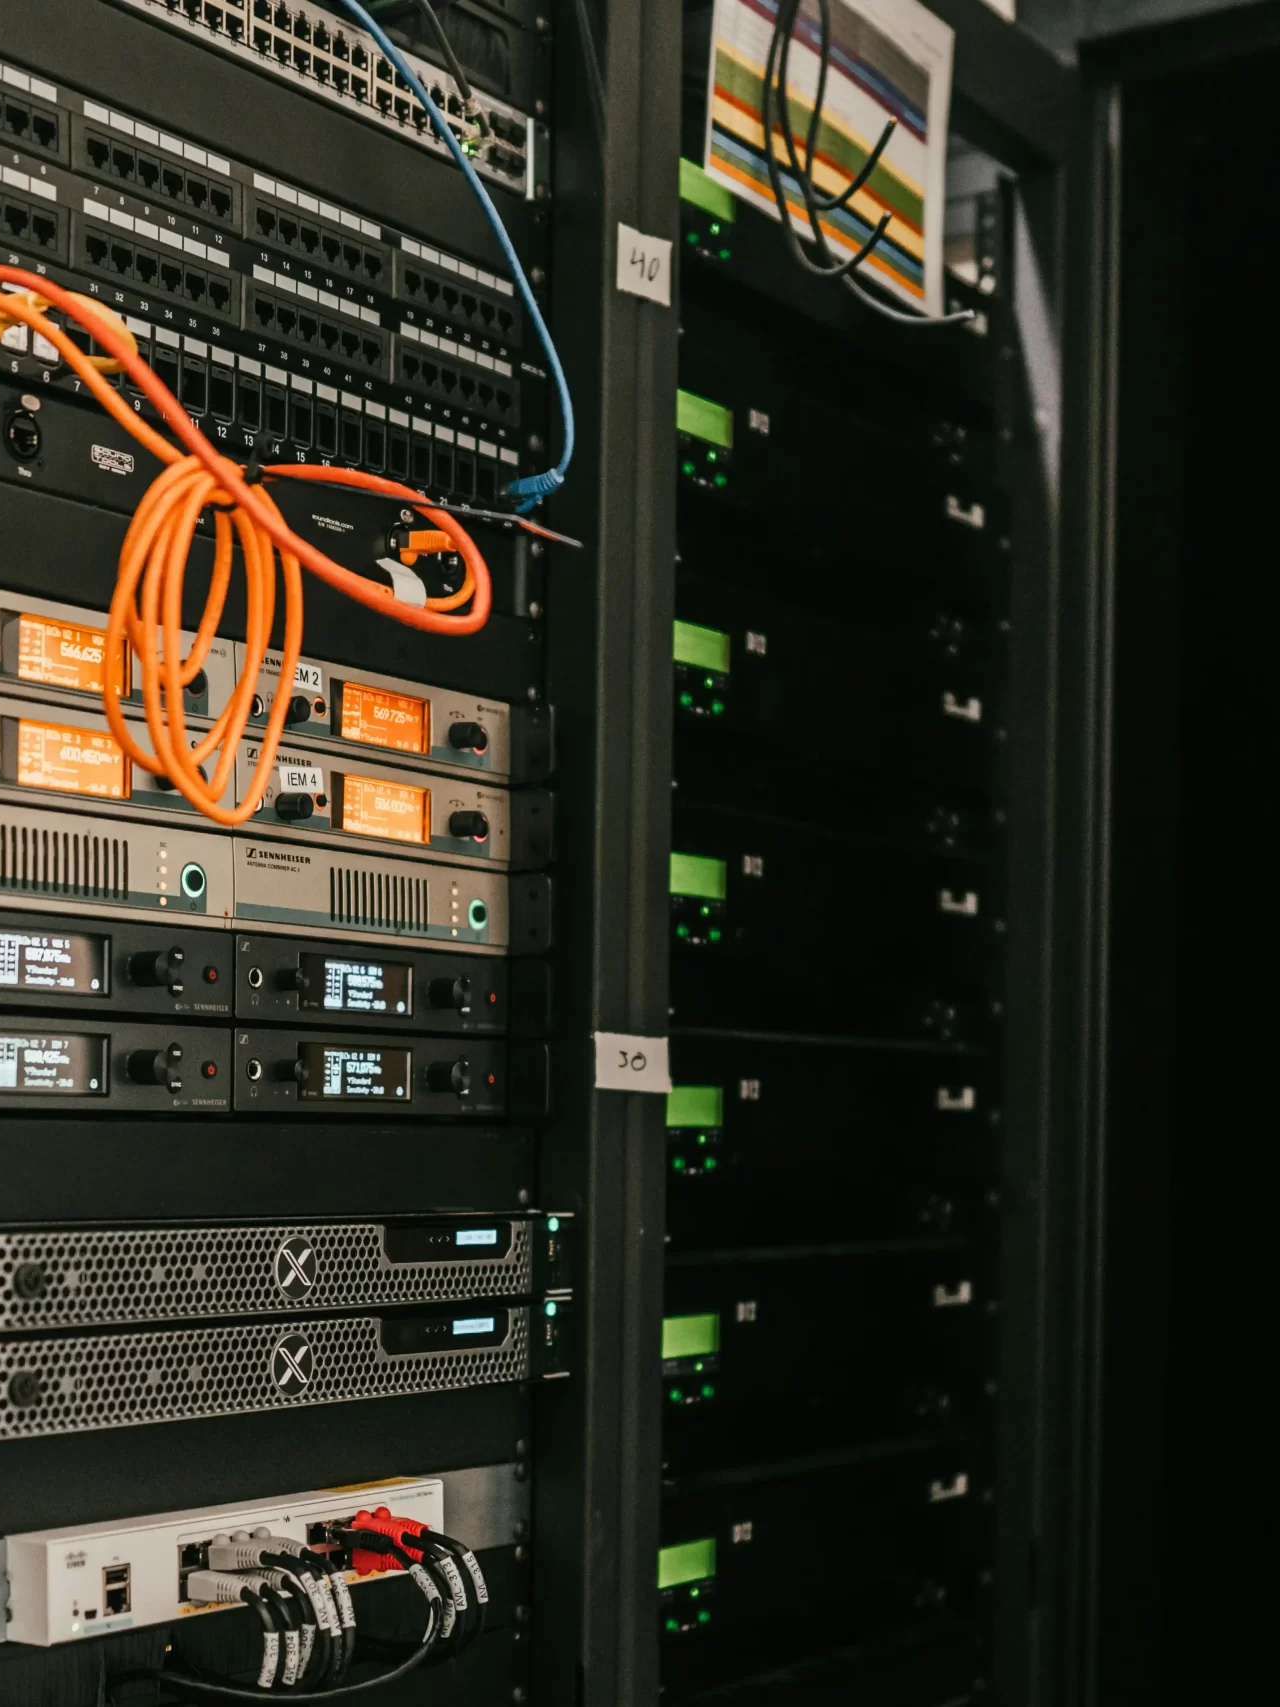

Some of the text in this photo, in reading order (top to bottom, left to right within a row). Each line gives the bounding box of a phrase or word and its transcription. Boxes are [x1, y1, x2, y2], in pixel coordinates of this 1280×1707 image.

[94, 186, 223, 244] 7 8 9 10 11 12
[630, 246, 661, 282] 40
[260, 252, 374, 304] 13 14 15 16 17 18
[90, 283, 99, 293] 31
[115, 292, 124, 303] 32
[140, 301, 149, 311] 33
[164, 310, 173, 320] 34
[188, 318, 197, 328] 35
[258, 344, 372, 391] 37 38 39 40 41 42
[11, 360, 19, 373] 5
[42, 371, 50, 383] 6
[74, 380, 81, 392] 7
[134, 401, 141, 412] 9
[217, 427, 227, 439] 12
[244, 435, 254, 447] 13
[296, 452, 306, 463] 15
[440, 496, 448, 507] 21
[312, 514, 354, 530] soundtools.com
[312, 672, 319, 686] 2
[288, 772, 317, 787] IEM 4
[246, 860, 267, 869] ANTENNA
[268, 864, 290, 872] COMBINER
[259, 850, 311, 865] SENNHEISER
[194, 1004, 229, 1012] SENNHEISER
[618, 1050, 647, 1072] 30
[192, 1098, 227, 1106] SENNHEISER
